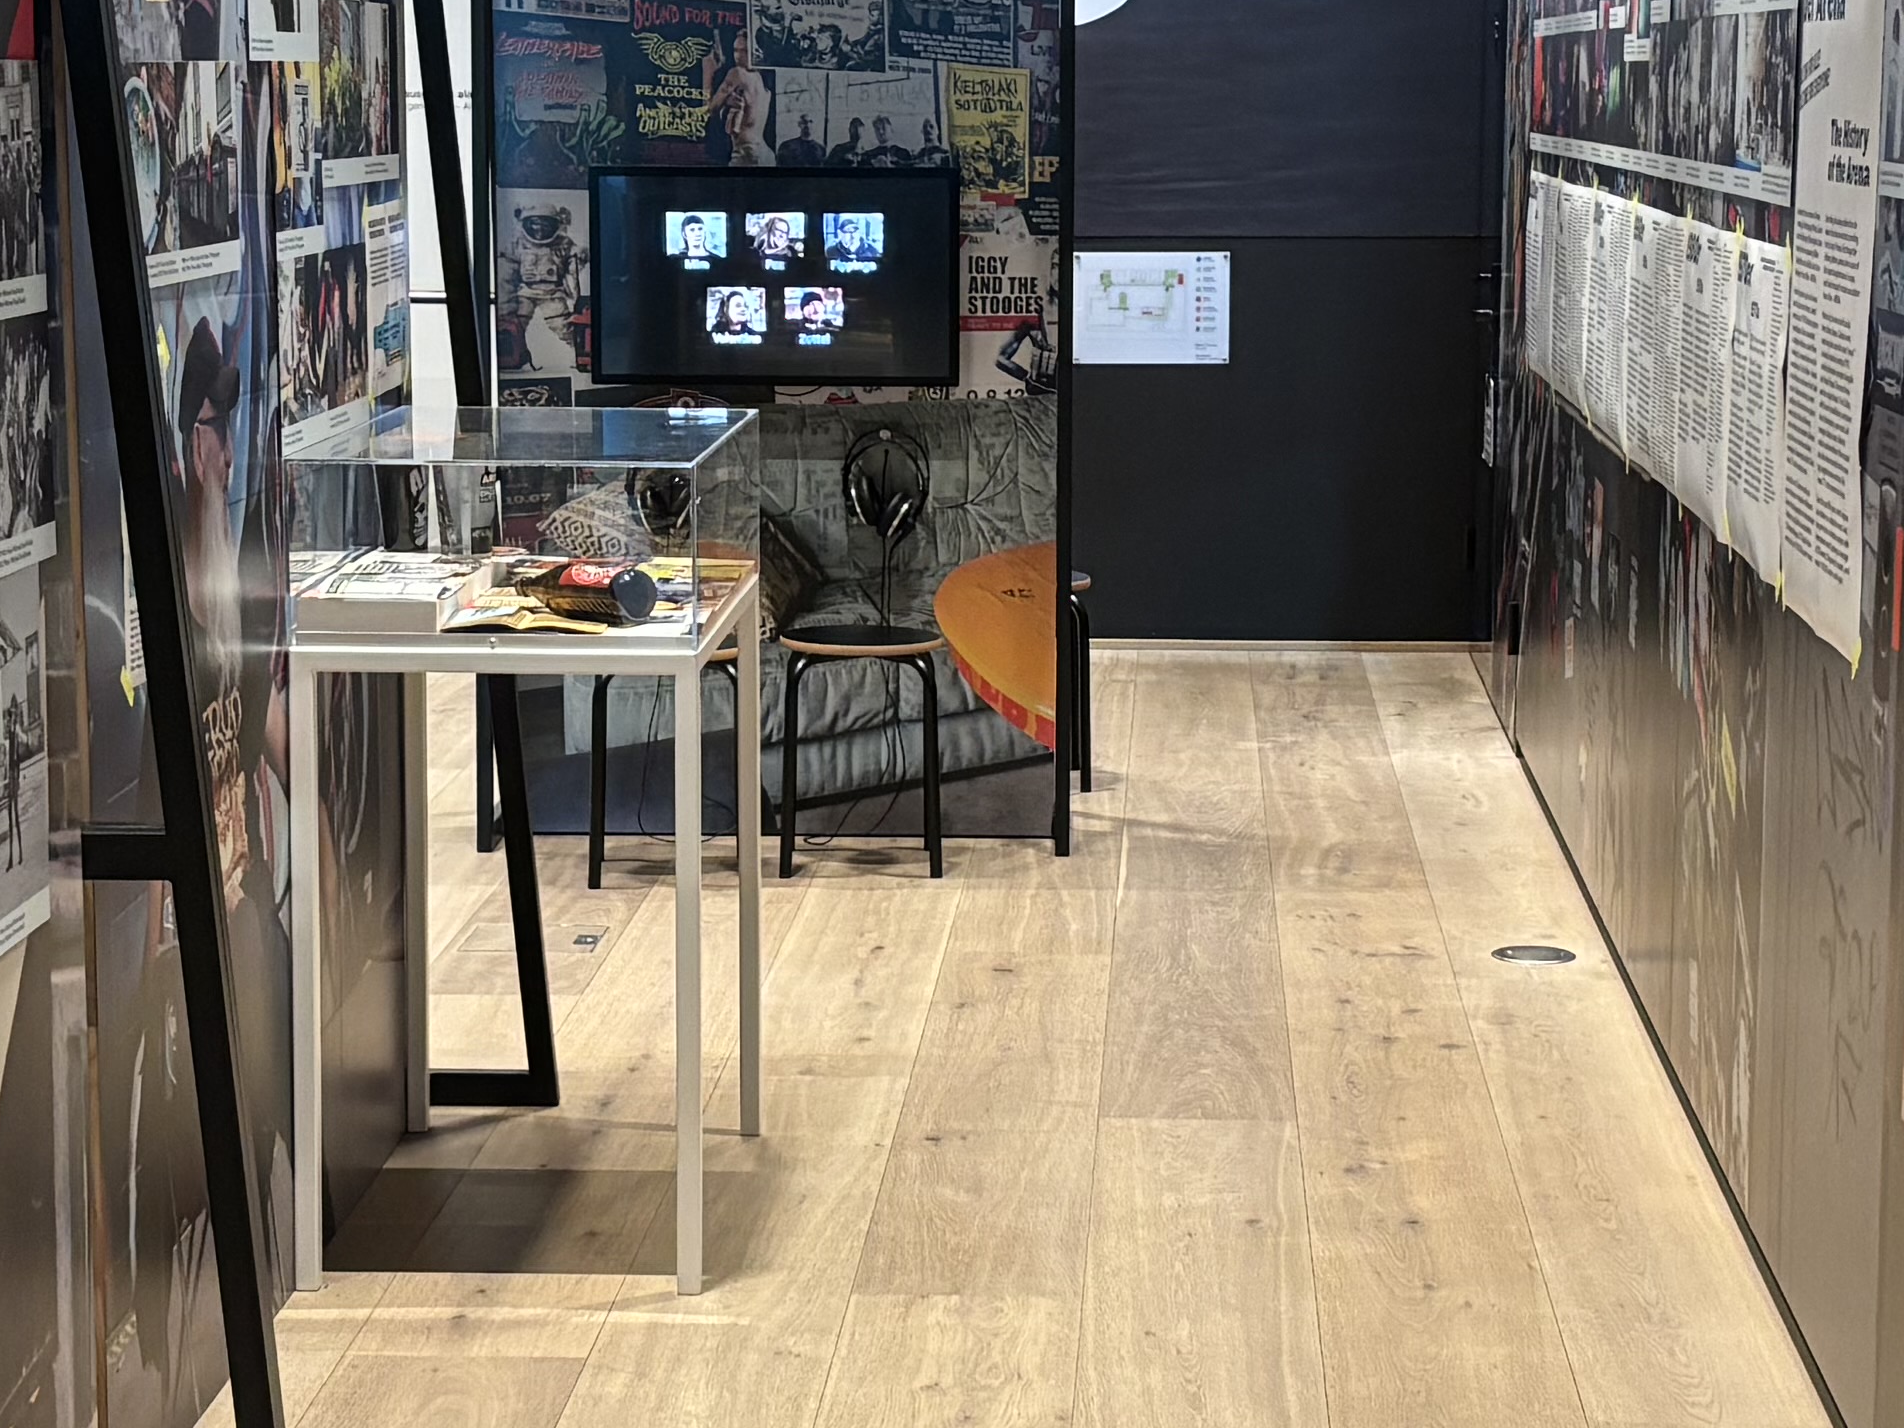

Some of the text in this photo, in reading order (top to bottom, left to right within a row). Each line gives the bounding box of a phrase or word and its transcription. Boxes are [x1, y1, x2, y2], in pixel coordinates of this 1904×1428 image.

[684, 8, 713, 28] FOR
[657, 74, 689, 86] THE
[635, 84, 711, 100] PEACOCKS
[638, 117, 707, 138] OUTCASTS
[1831, 118, 1870, 157] The History
[968, 255, 1009, 275] IGGY
[968, 277, 1039, 295] AND THE
[968, 295, 1044, 315] STOOGES
